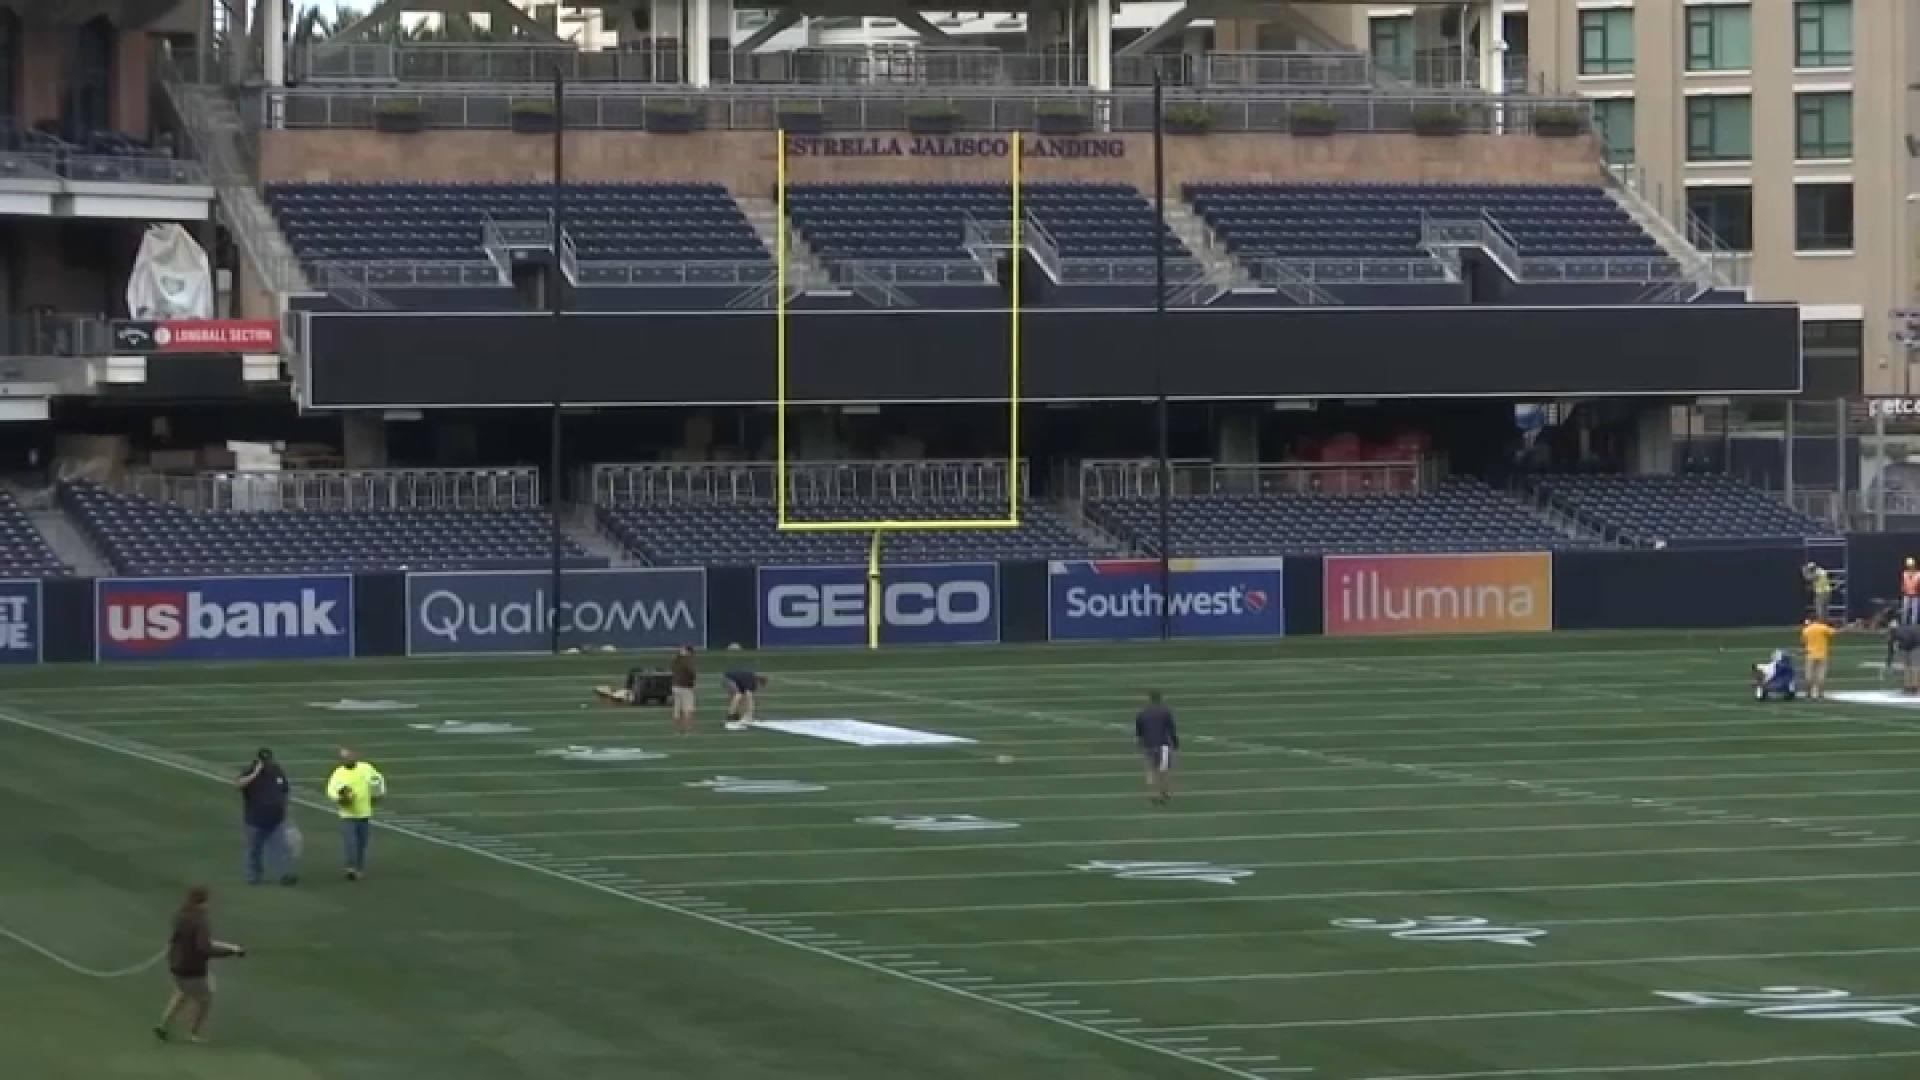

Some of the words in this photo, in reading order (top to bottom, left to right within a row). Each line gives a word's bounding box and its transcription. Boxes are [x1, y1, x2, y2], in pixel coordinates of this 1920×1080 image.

[909, 137, 1009, 157] JALISCO
[420, 588, 695, 642] Qualcomm
[767, 581, 990, 628] GECO
[1066, 583, 1244, 617] Southwest
[1341, 570, 1534, 622] illumina
